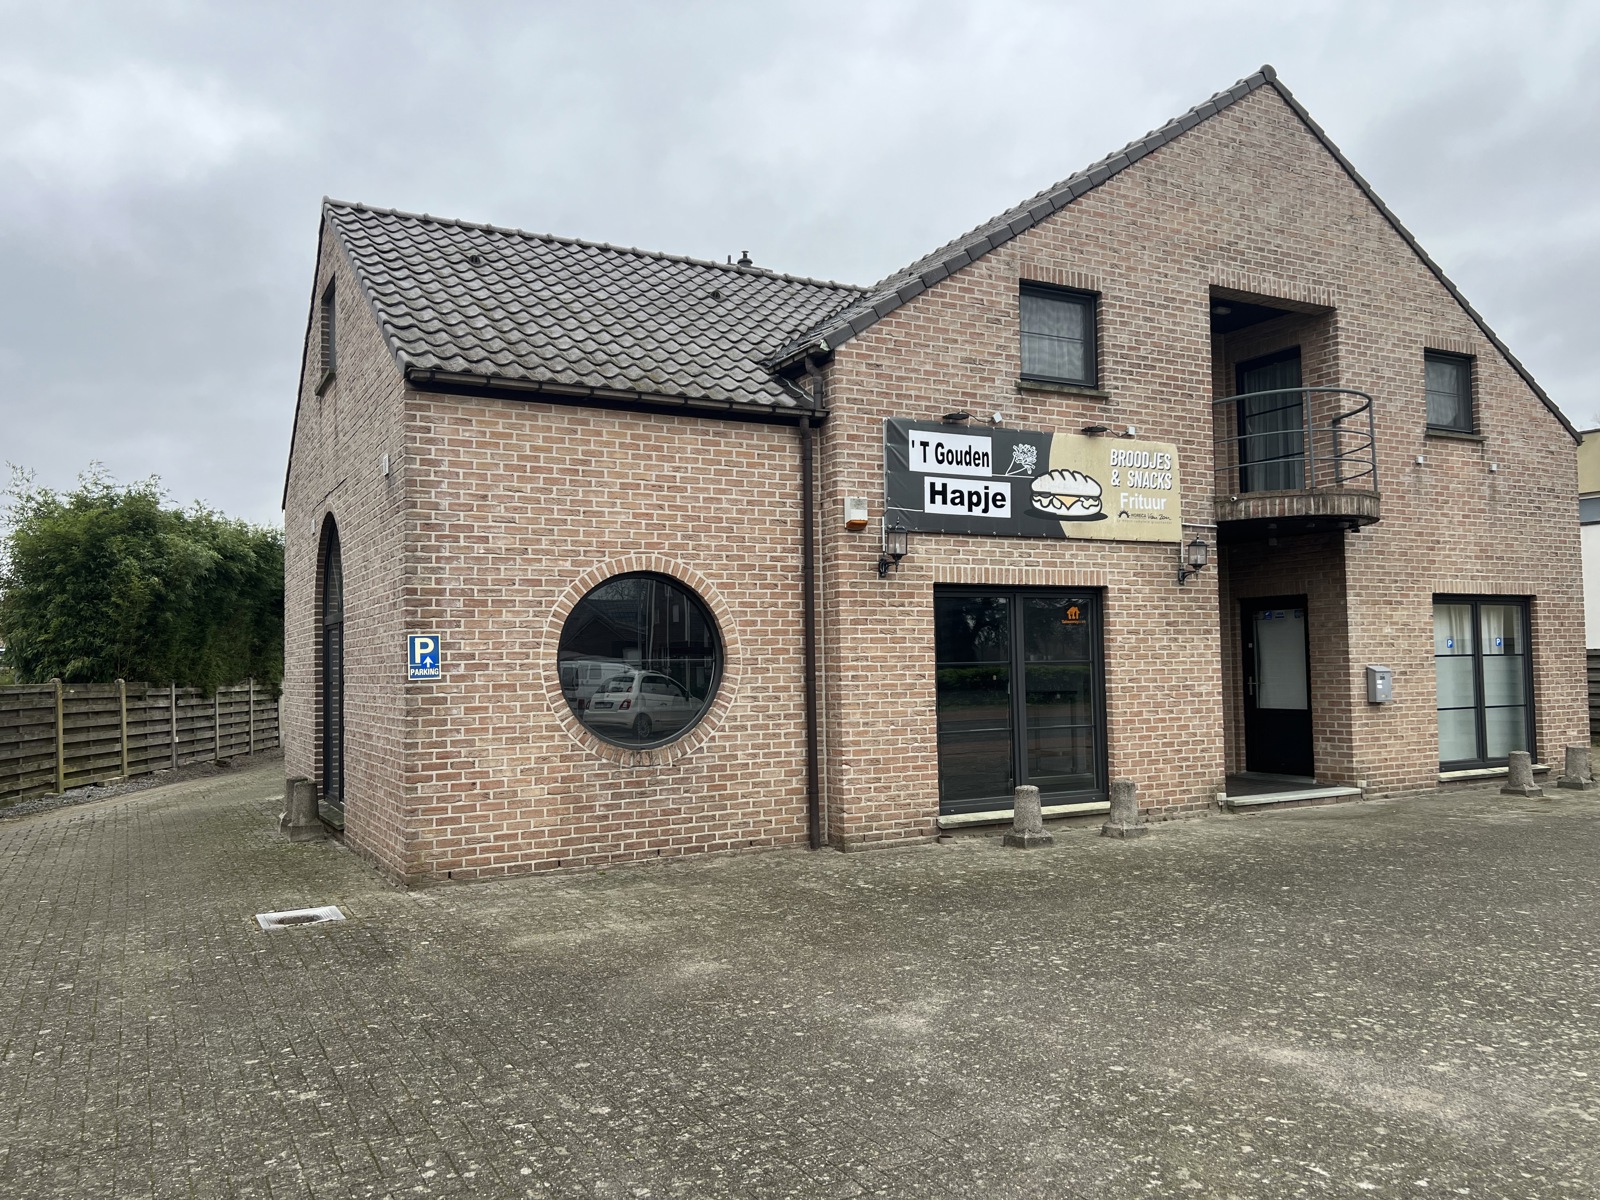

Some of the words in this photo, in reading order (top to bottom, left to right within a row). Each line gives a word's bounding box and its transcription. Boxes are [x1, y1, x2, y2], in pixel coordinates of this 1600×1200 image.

[935, 442, 989, 467] Gouden
[1110, 449, 1172, 470] BROODJES
[1110, 469, 1120, 487] &
[1127, 470, 1172, 490] SNACKS
[930, 482, 1006, 513] Hapje
[1120, 492, 1167, 510] Frituur
[415, 638, 434, 663] P
